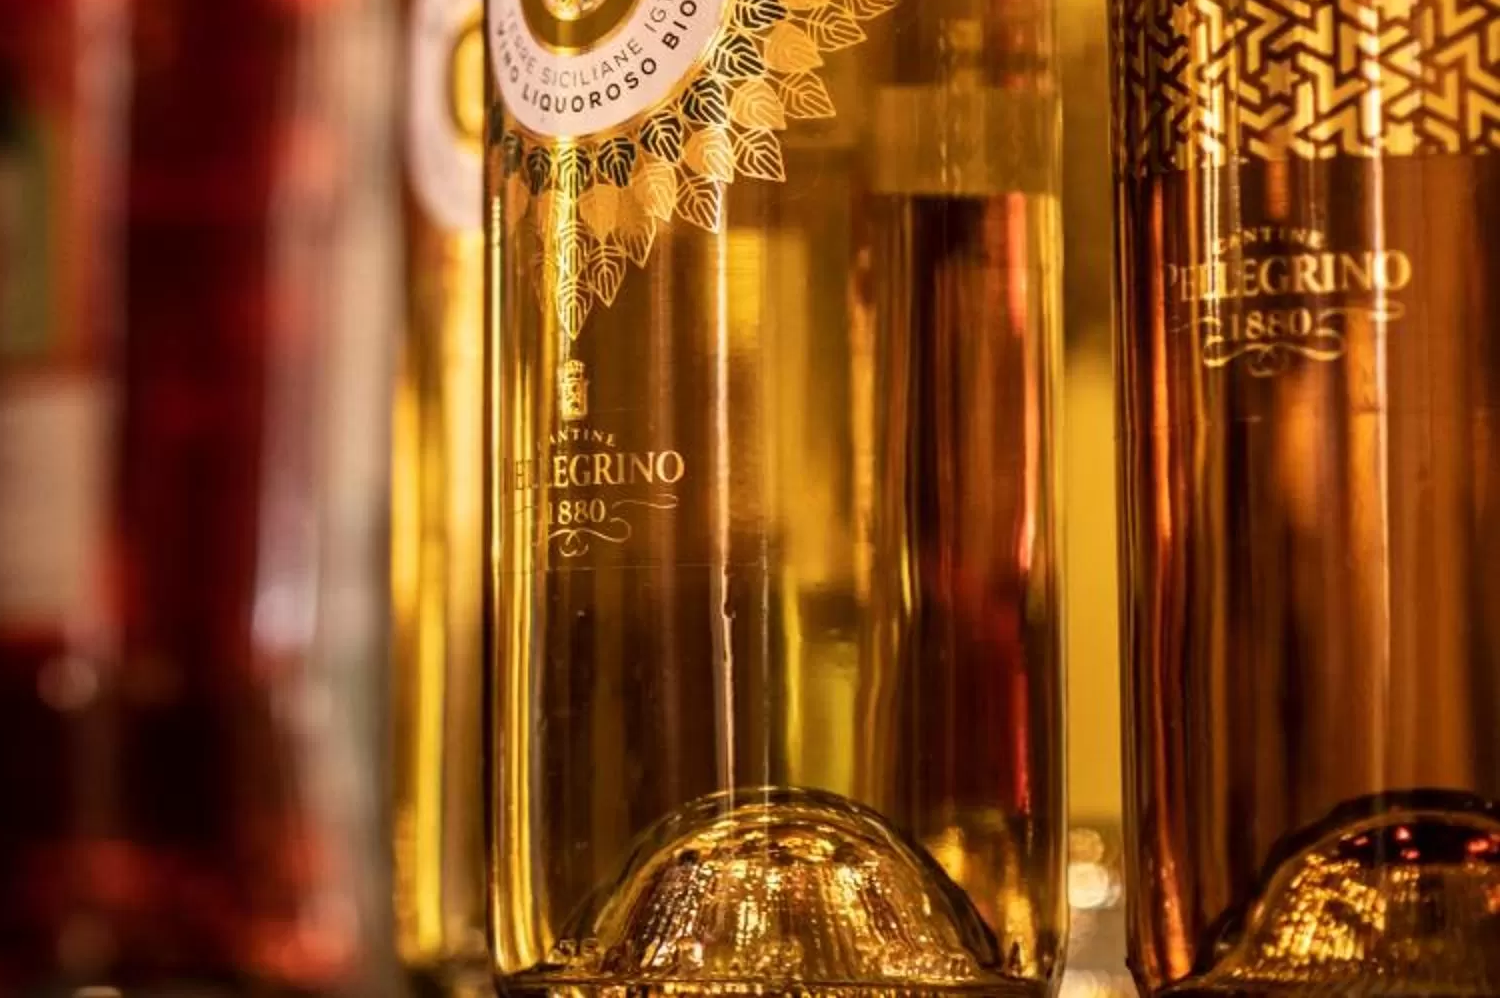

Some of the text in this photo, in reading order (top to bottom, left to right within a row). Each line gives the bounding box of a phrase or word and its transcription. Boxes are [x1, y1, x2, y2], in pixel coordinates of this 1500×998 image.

[521, 57, 658, 115] LIQUOROSO
[661, 0, 698, 51] BIO
[540, 38, 643, 89] SICILIANE
[547, 498, 607, 526] 1880
